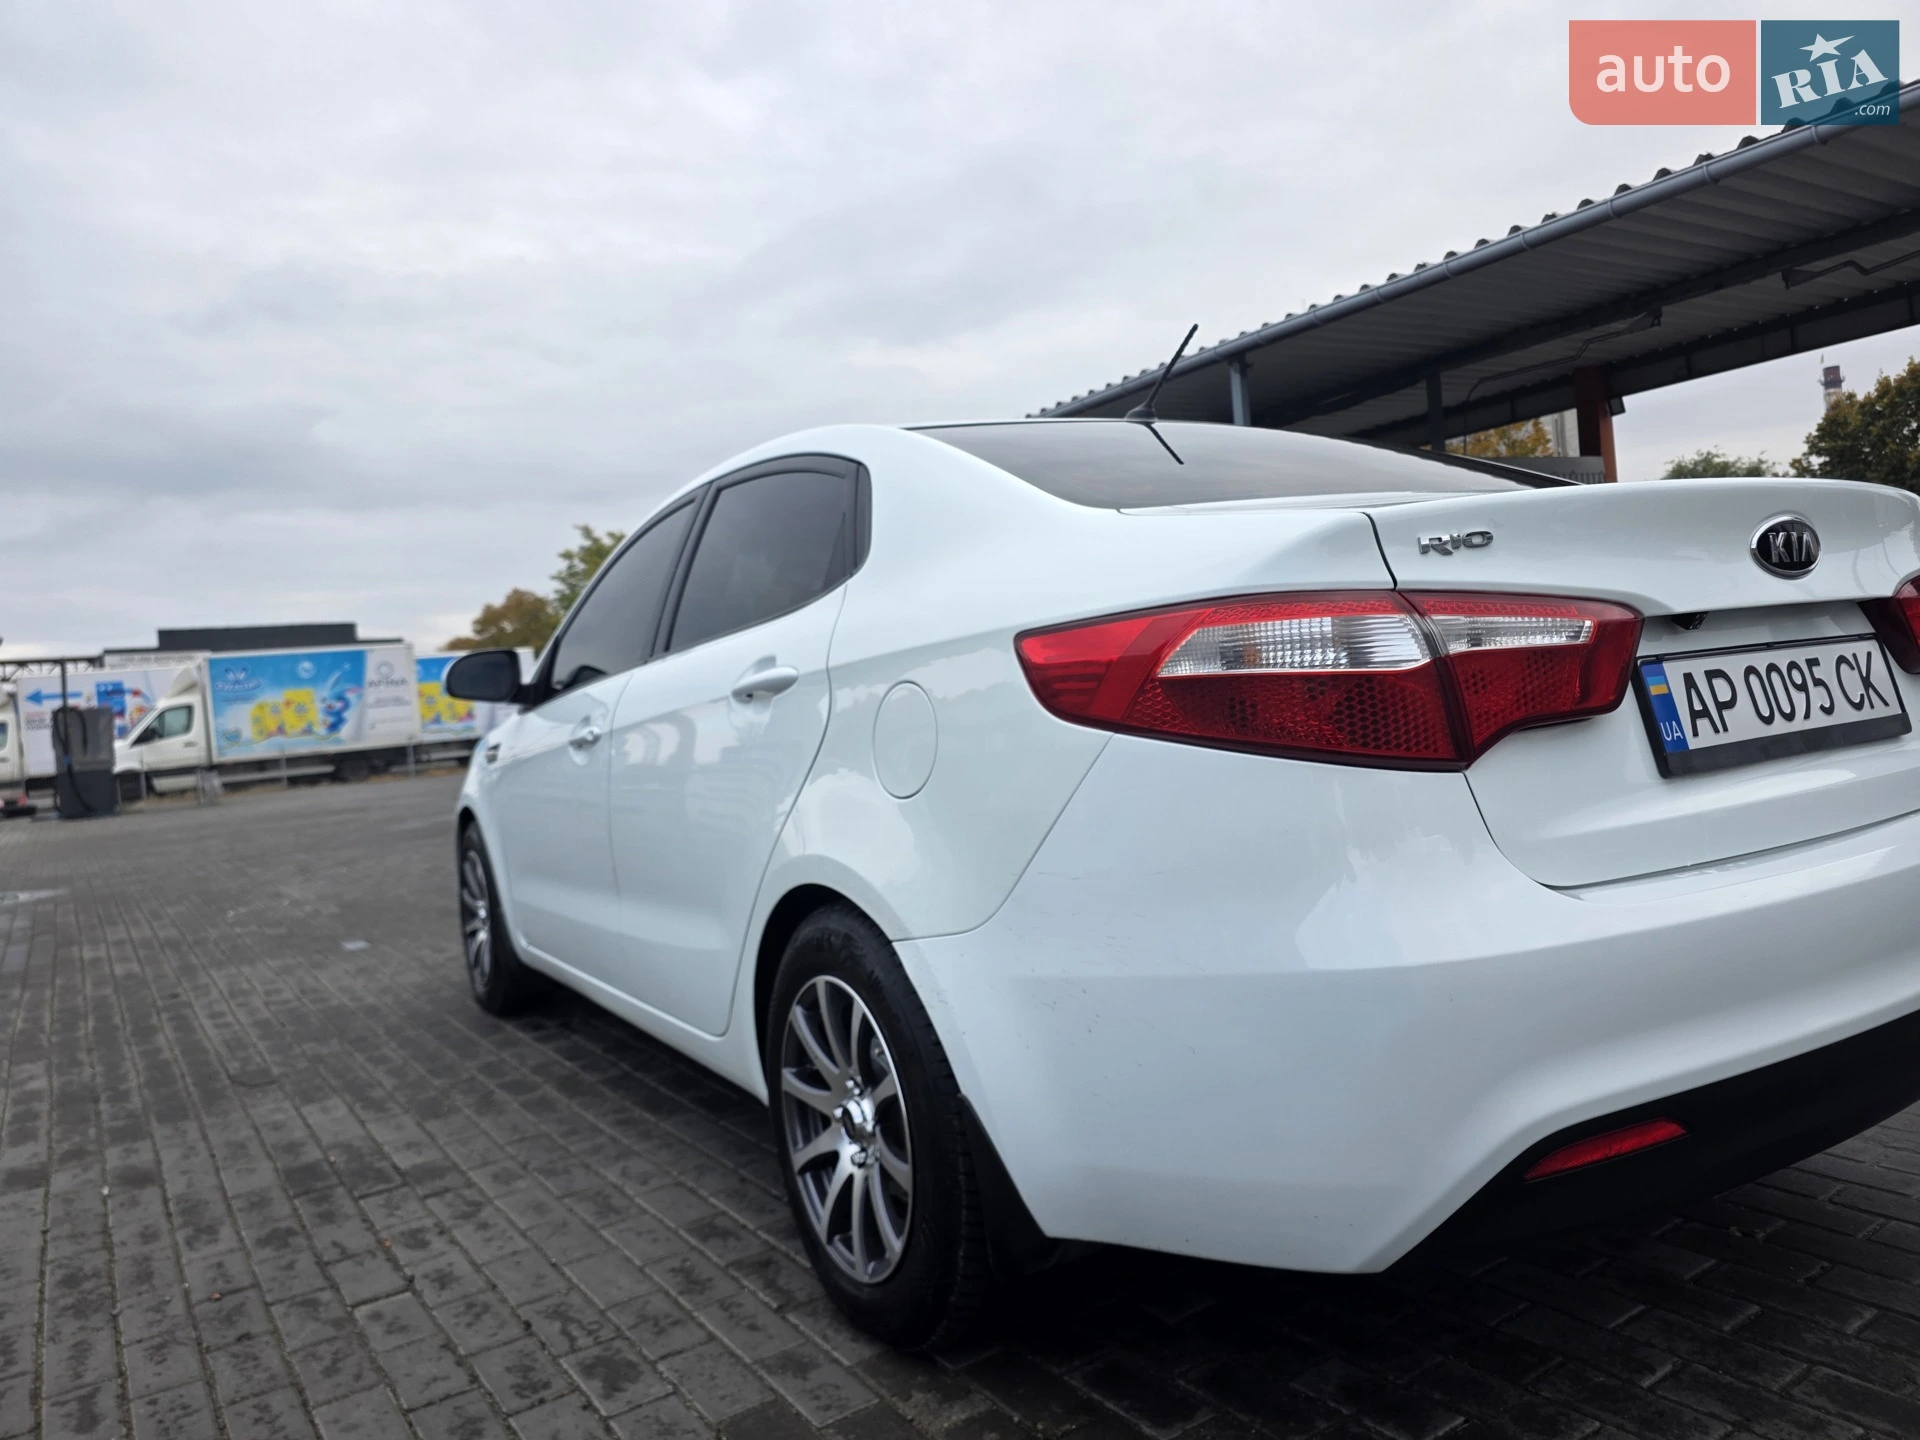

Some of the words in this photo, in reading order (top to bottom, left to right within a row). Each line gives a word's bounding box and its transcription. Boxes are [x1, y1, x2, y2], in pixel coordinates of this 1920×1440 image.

[1417, 530, 1494, 556] RIO
[1767, 531, 1817, 563] KIA
[1682, 668, 1738, 738] AP
[1743, 656, 1835, 726] 0095
[1835, 650, 1890, 712] CK
[1660, 720, 1684, 742] UA
